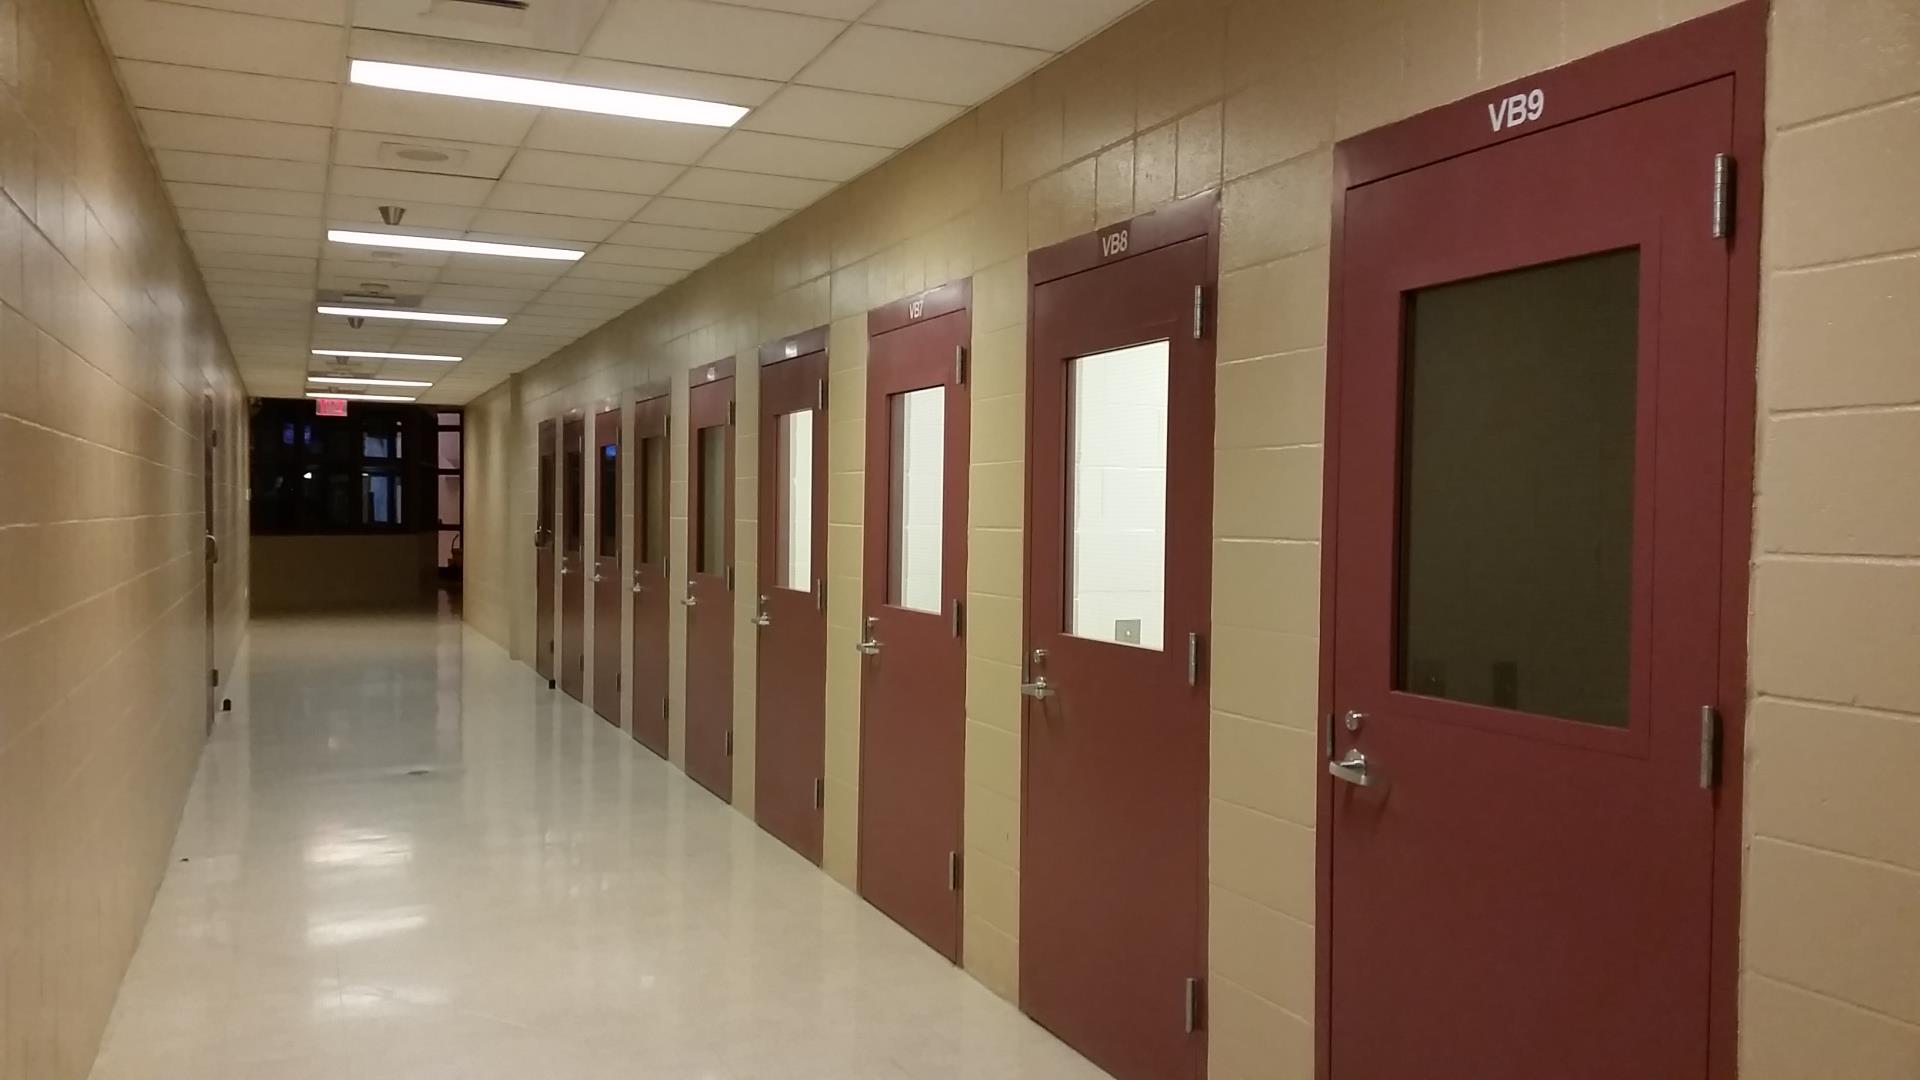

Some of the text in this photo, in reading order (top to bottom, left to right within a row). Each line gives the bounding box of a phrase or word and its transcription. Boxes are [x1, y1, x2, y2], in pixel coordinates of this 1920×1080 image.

[1488, 88, 1544, 132] VB9
[1102, 230, 1128, 257] VB8
[909, 299, 924, 319] VB7
